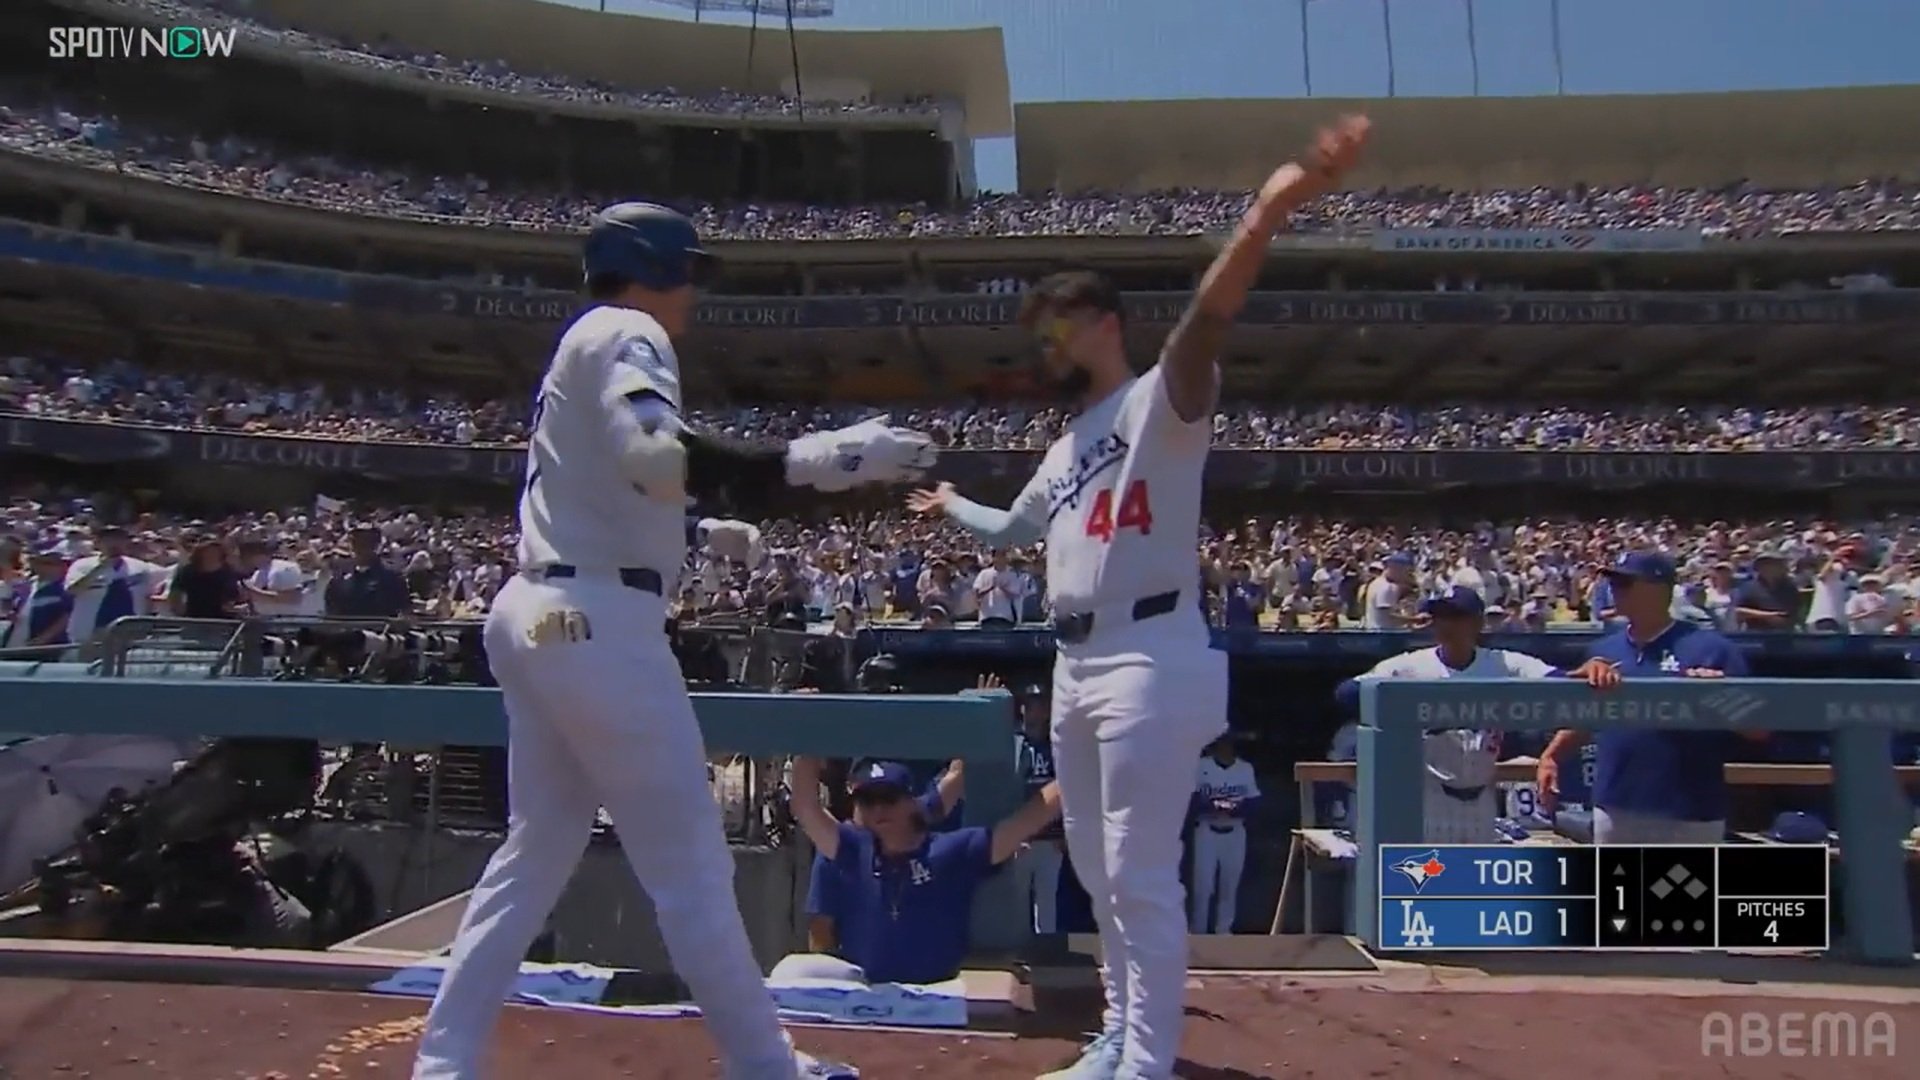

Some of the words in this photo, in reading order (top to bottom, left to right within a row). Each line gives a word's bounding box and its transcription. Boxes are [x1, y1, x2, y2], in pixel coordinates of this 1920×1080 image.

[1395, 237, 1440, 249] BANK
[1447, 236, 1470, 249] OF
[1475, 236, 1555, 249] AMERICA
[475, 296, 575, 318] DECORT
[1086, 480, 1152, 542] 44
[1417, 702, 1500, 722] BANK
[1508, 702, 1546, 721] OF
[1554, 701, 1695, 721] AMERICA
